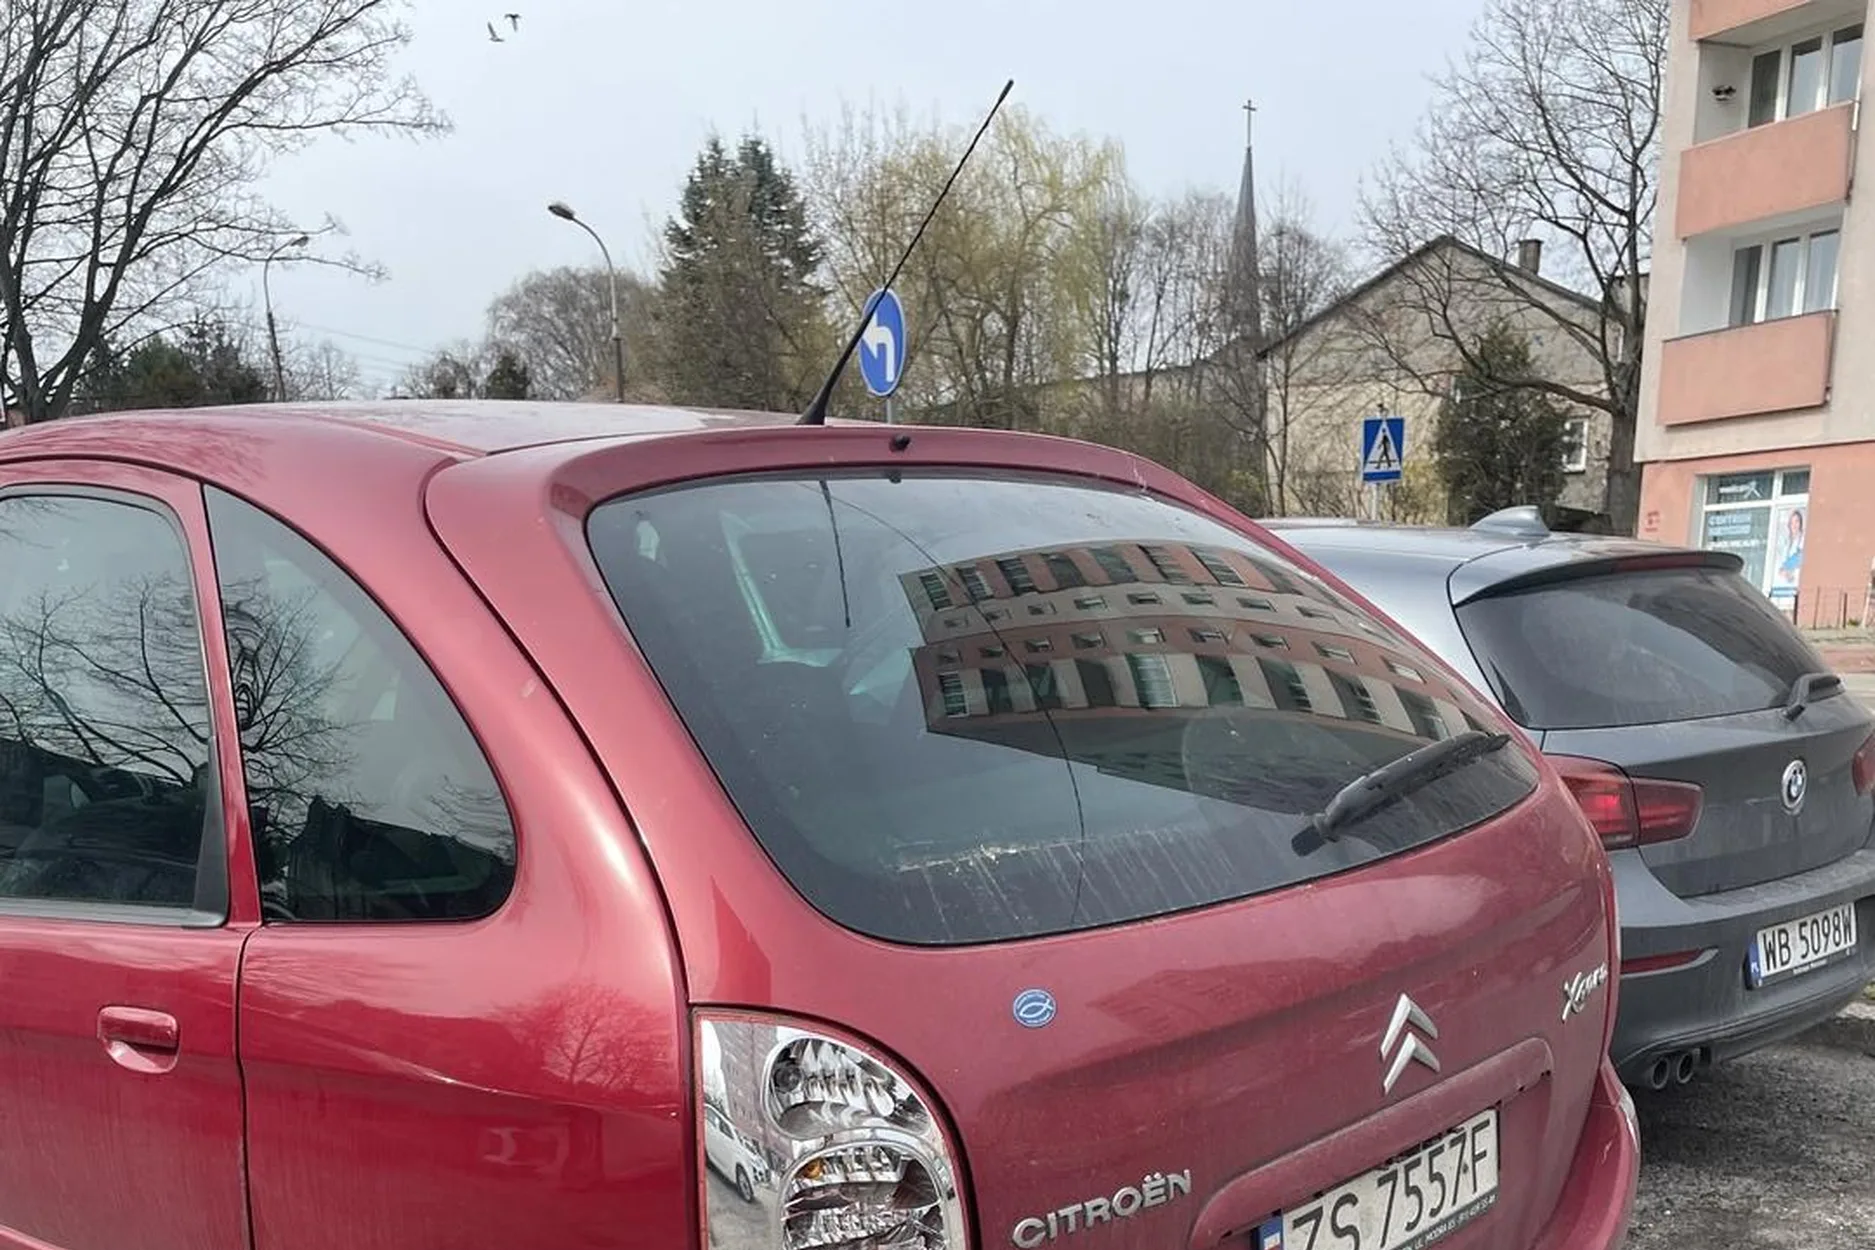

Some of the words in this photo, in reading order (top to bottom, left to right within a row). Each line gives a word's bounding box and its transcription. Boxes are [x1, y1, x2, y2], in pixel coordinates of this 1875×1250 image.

[1763, 928, 1792, 972] WB
[1798, 904, 1853, 960] 5098W
[1012, 1168, 1192, 1249] CITROËN
[1377, 1118, 1490, 1248] 7557F
